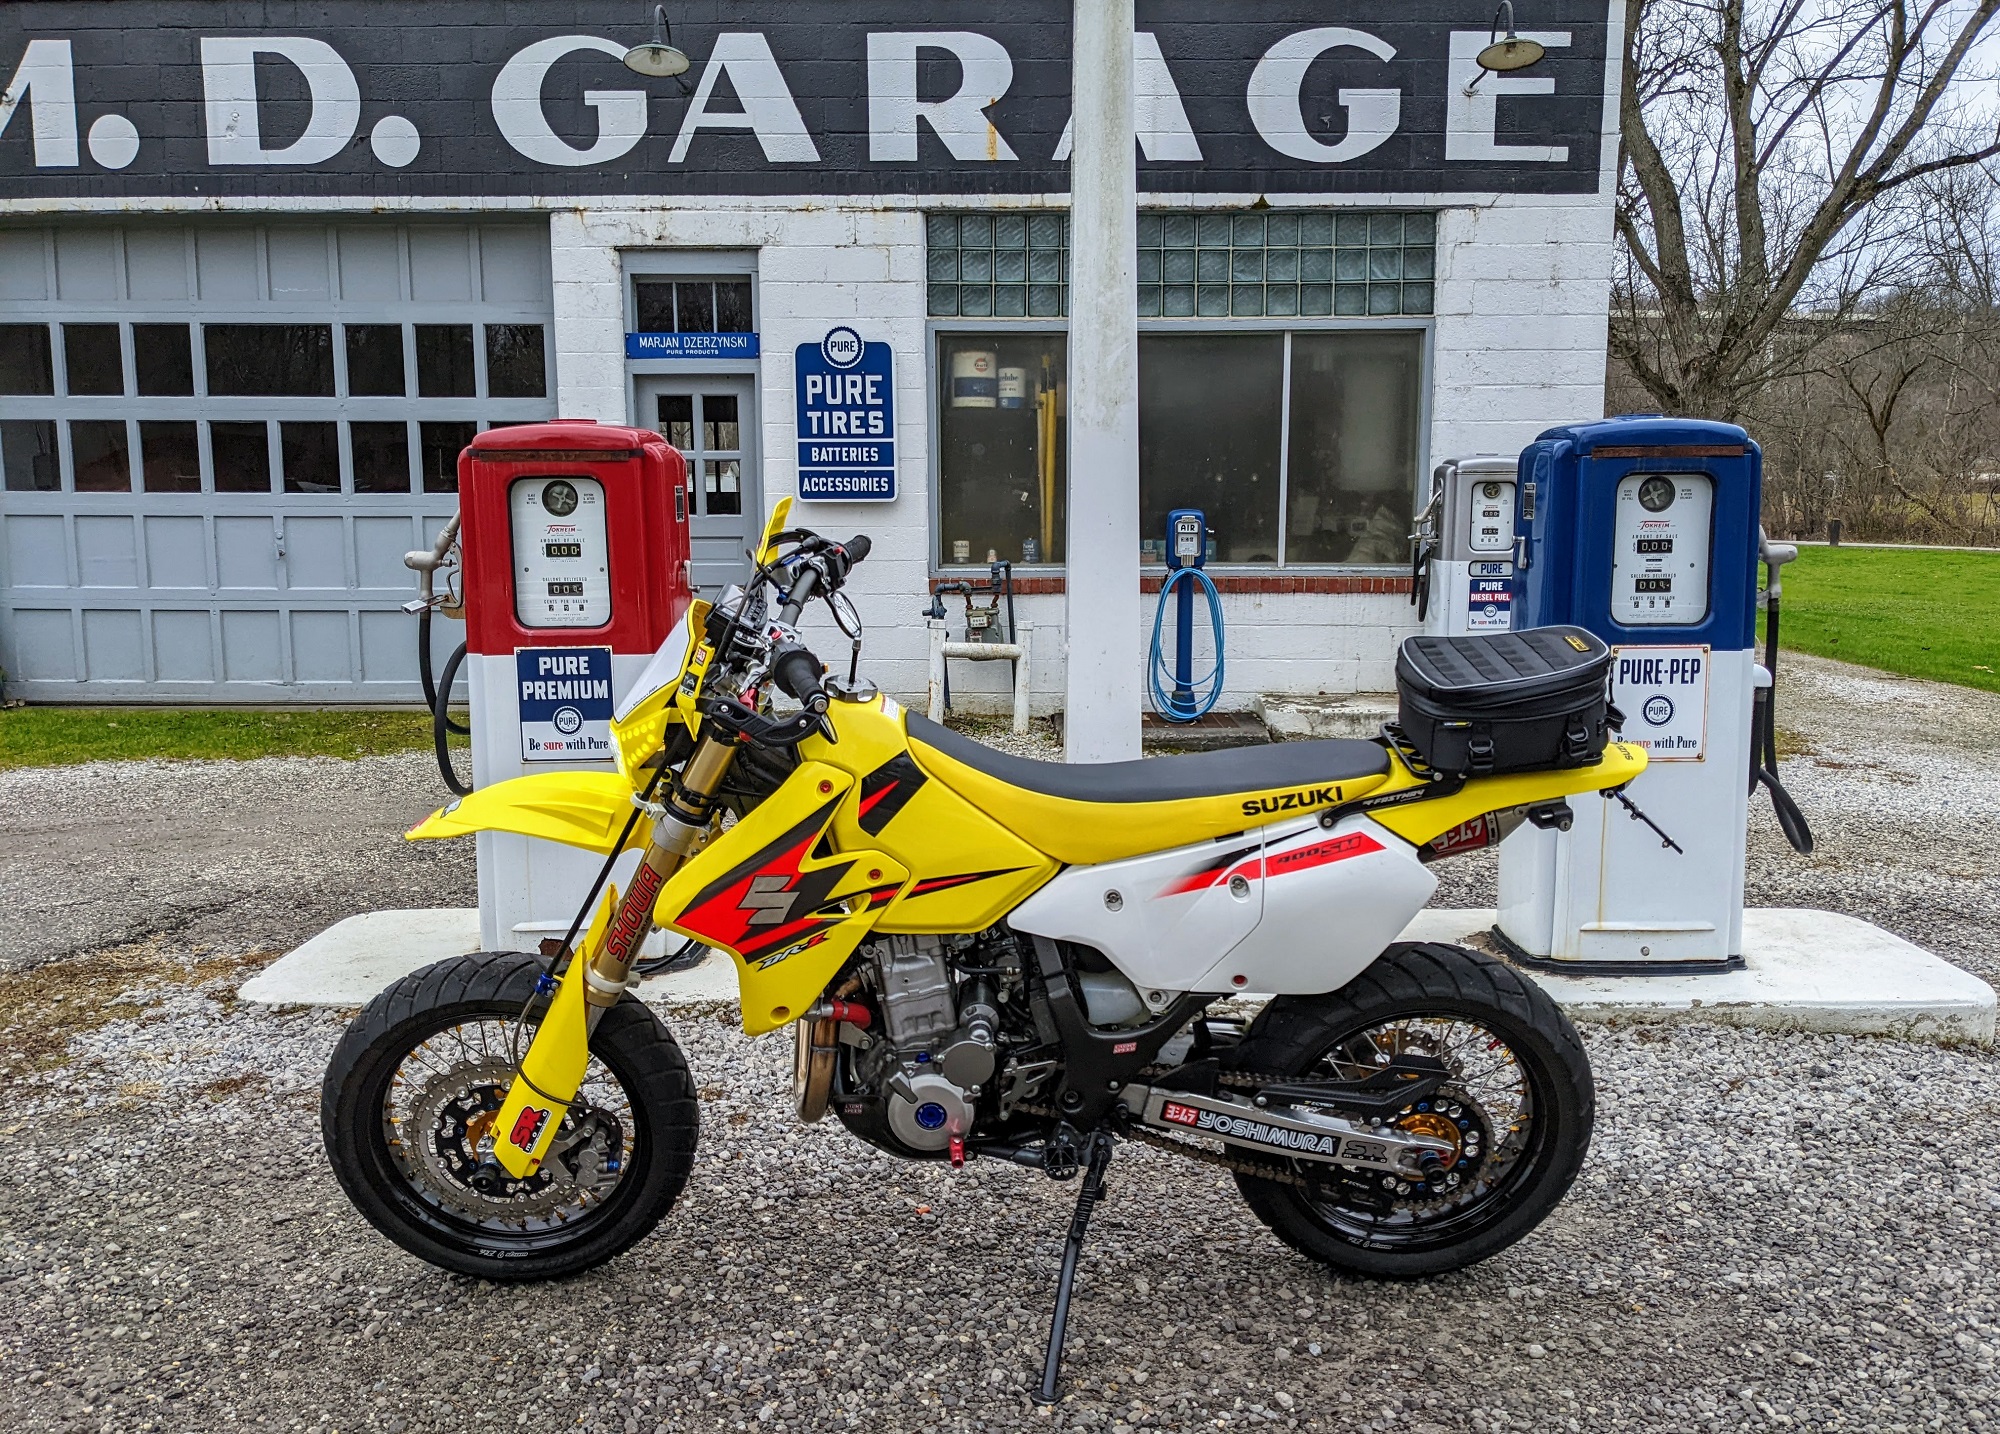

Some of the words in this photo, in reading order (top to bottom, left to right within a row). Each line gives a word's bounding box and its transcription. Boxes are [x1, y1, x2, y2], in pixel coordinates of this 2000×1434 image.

[201, 36, 421, 167] D.
[640, 337, 679, 348] MARJAN
[683, 337, 747, 348] DZERZYNSKI
[830, 341, 856, 352] PURE
[806, 374, 883, 405] PURE
[806, 411, 884, 435] TIRES
[811, 447, 879, 462] BATTERIES
[802, 477, 889, 492] ACCESSORIES
[546, 524, 576, 534] TOKHEIM
[1640, 520, 1671, 530] TOKHEIM
[1480, 563, 1503, 574] PURE
[1480, 581, 1504, 591] PURE
[1470, 593, 1493, 601] DIESEL
[1494, 593, 1510, 601] FUEL
[538, 656, 590, 676] PURE
[1619, 658, 1701, 685] PURE-PEP
[522, 679, 609, 700] PREMIUM
[1648, 706, 1668, 716] PURE
[558, 716, 578, 726] PURE
[529, 737, 541, 750] Be
[543, 741, 564, 750] sure
[566, 737, 587, 750] with
[588, 736, 609, 750] Pure
[1654, 737, 1675, 749] with
[1676, 736, 1697, 749] Pure
[1241, 786, 1343, 816] SUZUKI
[606, 863, 663, 963] SHOWA
[510, 1106, 543, 1150] SR
[524, 1111, 548, 1152] moto
[1197, 1109, 1335, 1155] YOSHIMURA
[1345, 1140, 1387, 1158] SR
